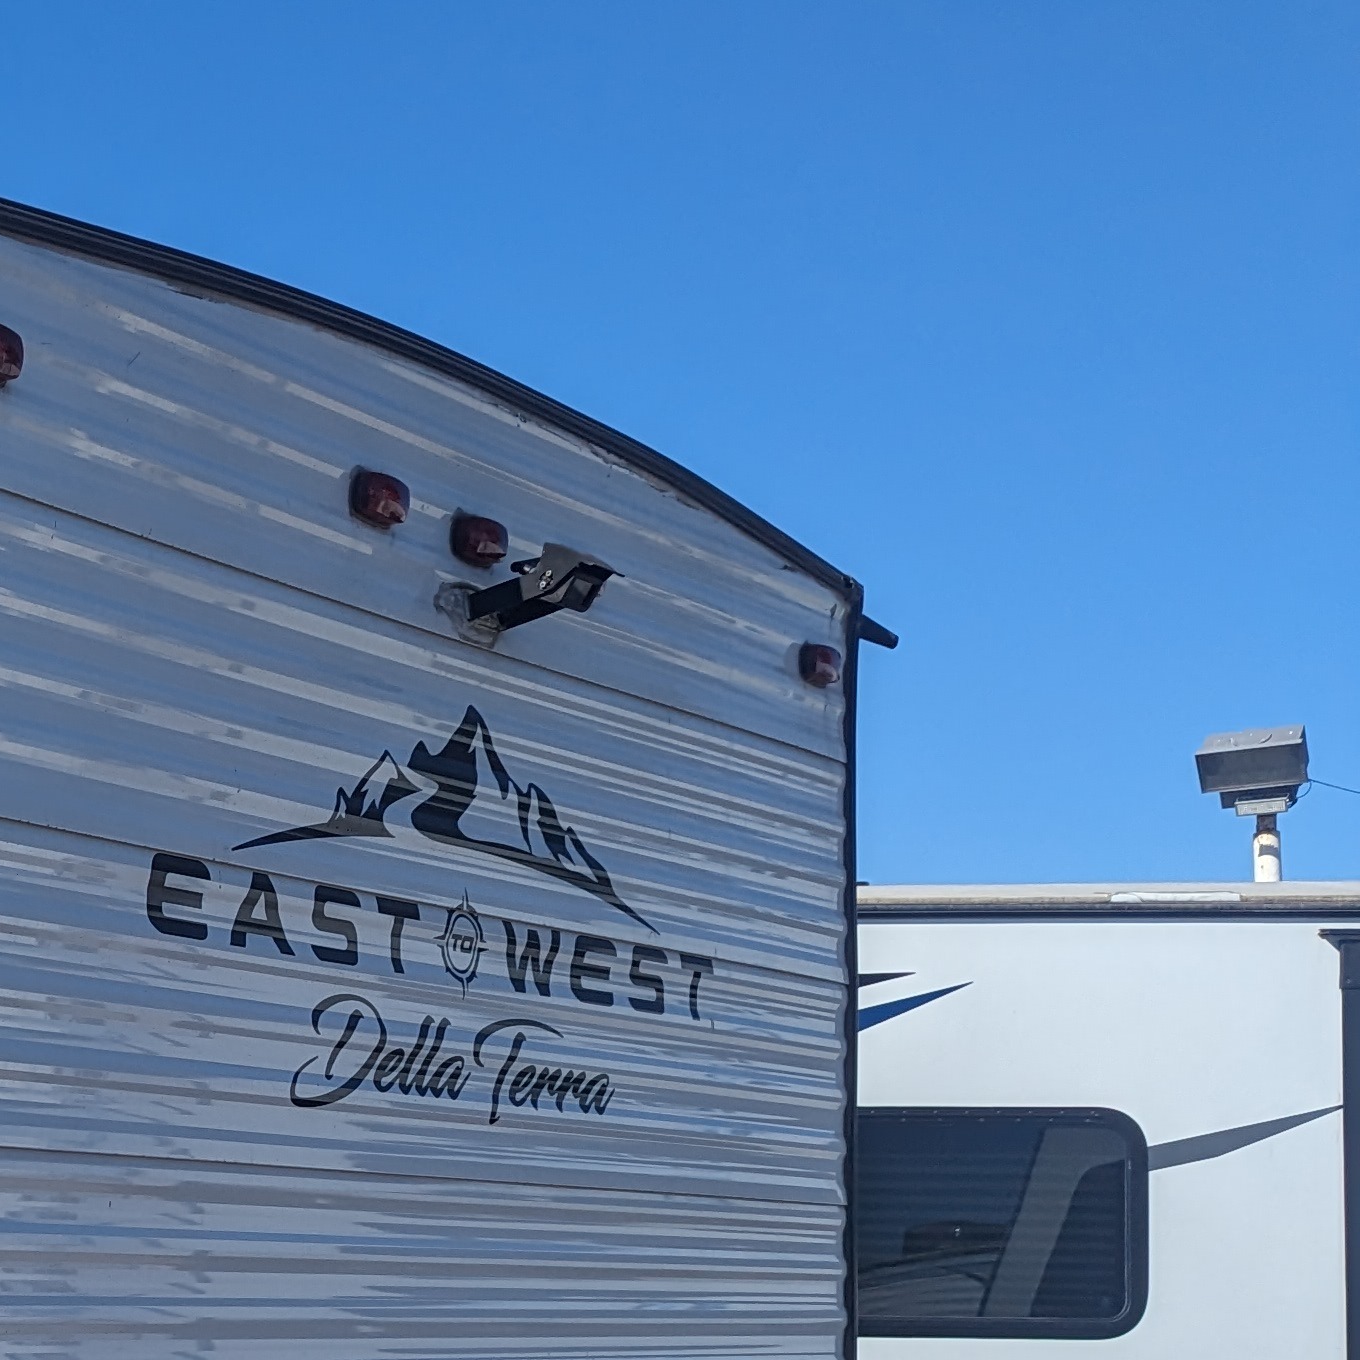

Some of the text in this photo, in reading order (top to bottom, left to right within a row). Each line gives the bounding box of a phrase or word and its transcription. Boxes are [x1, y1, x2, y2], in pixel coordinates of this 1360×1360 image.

[146, 852, 713, 1021] EAST TO WEST
[290, 993, 615, 1124] Della Terra
